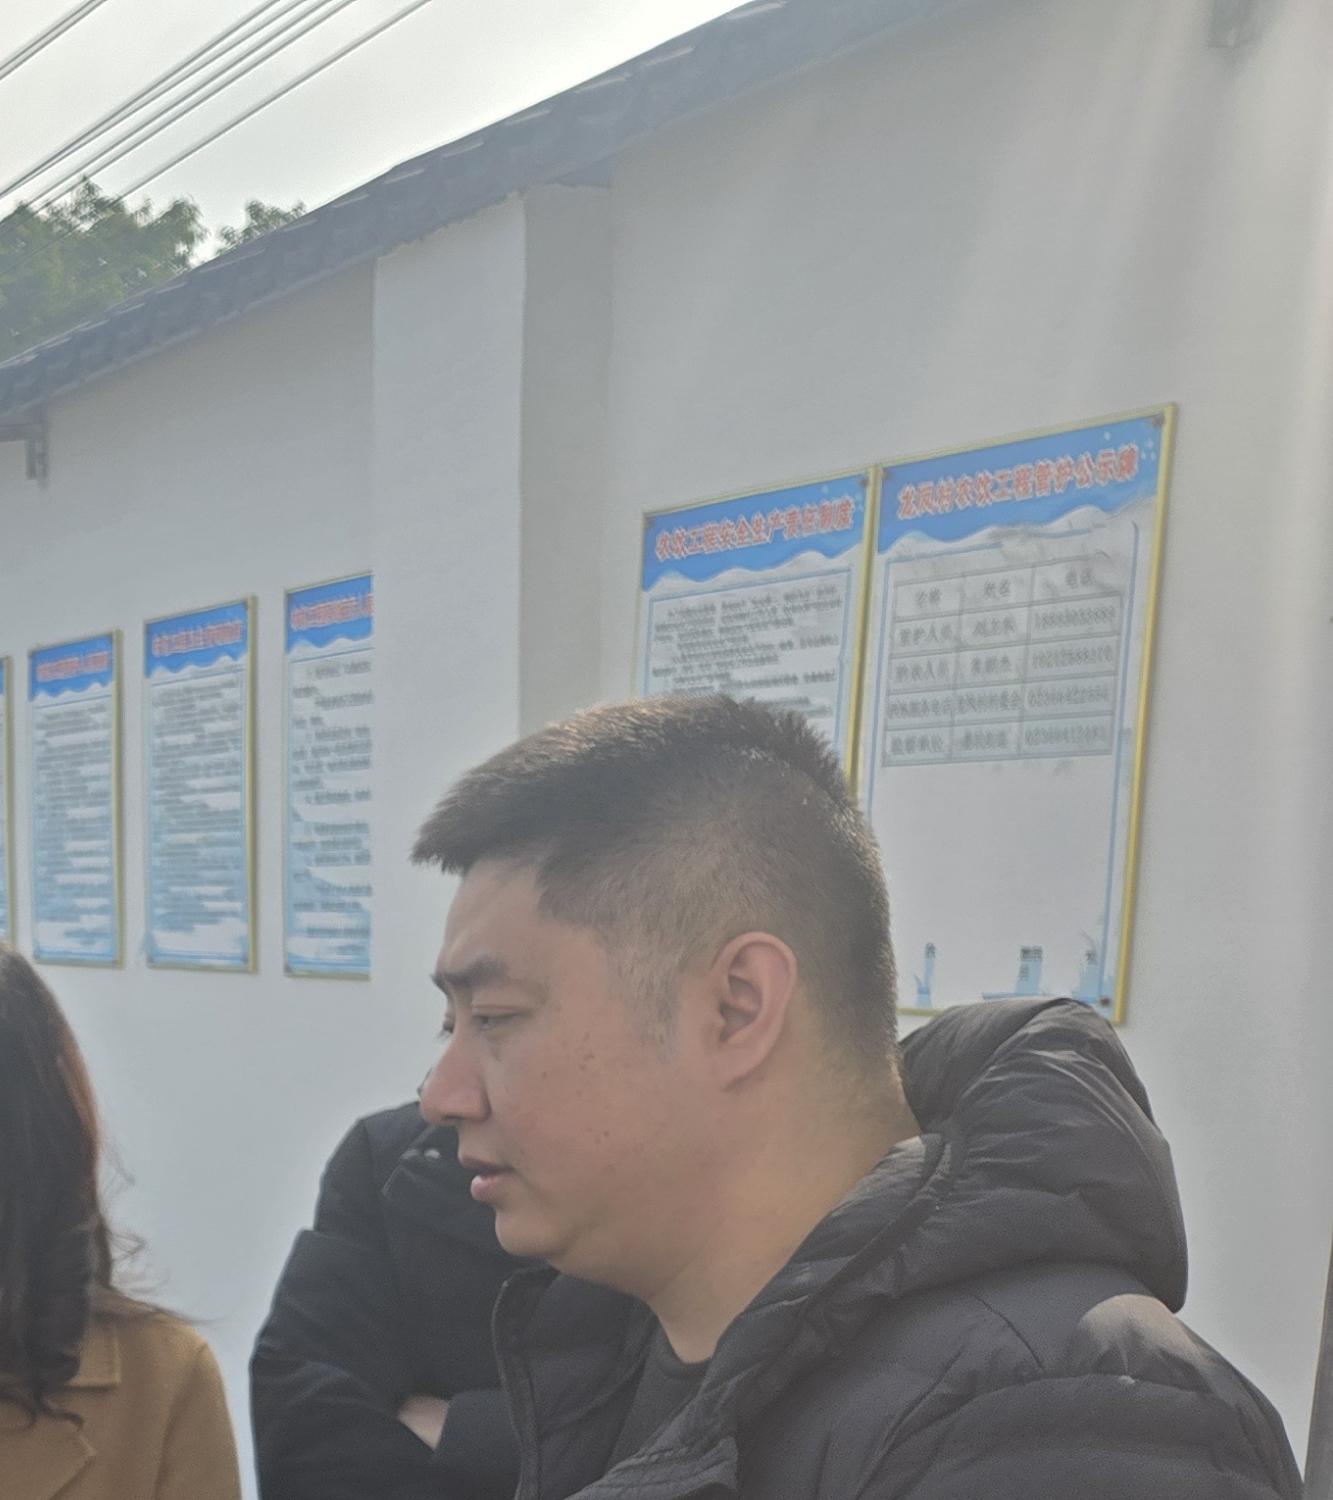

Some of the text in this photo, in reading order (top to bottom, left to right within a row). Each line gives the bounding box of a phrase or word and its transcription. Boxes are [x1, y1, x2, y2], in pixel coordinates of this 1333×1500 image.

[897, 442, 1139, 520] 龙凤村农饮工程管护公示牌
[655, 495, 855, 562] 农饮工程安全生产责任制度
